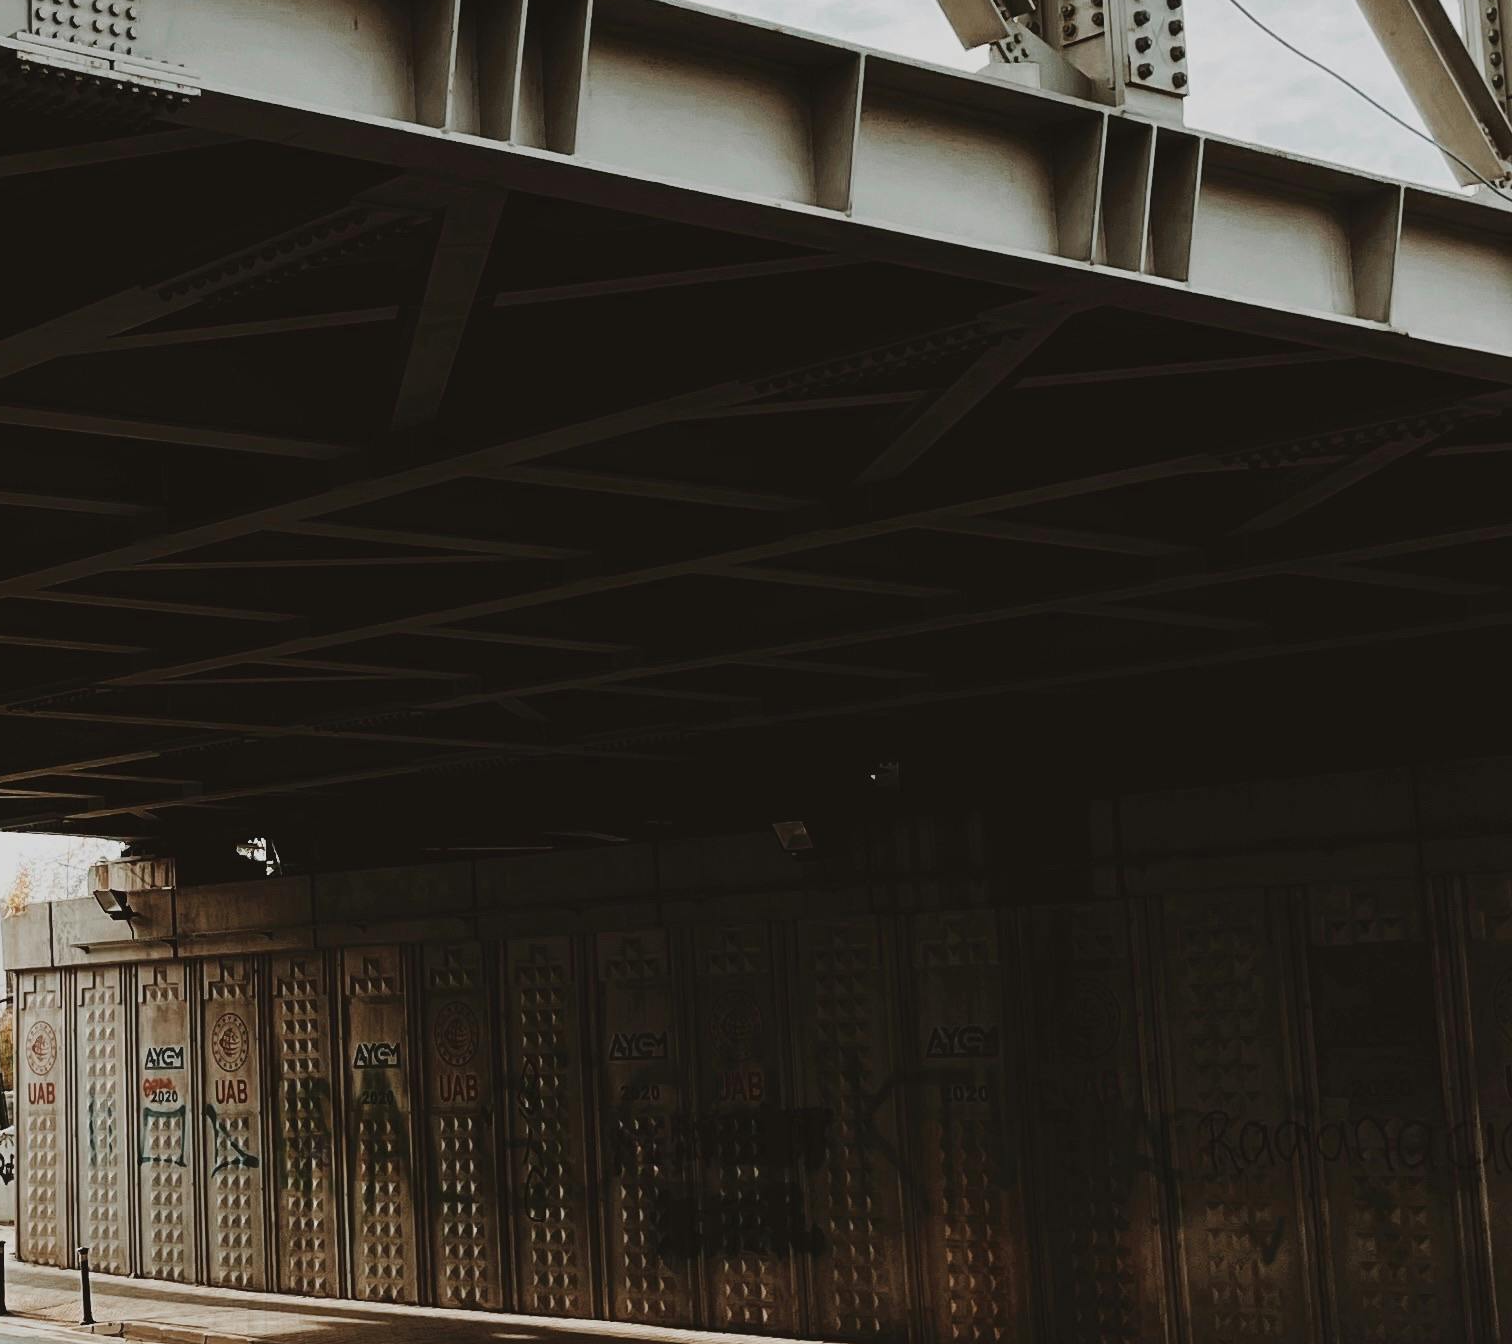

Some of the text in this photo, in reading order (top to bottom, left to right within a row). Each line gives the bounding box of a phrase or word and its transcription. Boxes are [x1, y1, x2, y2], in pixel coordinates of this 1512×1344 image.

[28, 1082, 56, 1105] UAB
[150, 1089, 179, 1103] 2020
[215, 1079, 248, 1104] UAB
[439, 1073, 479, 1102] UAB
